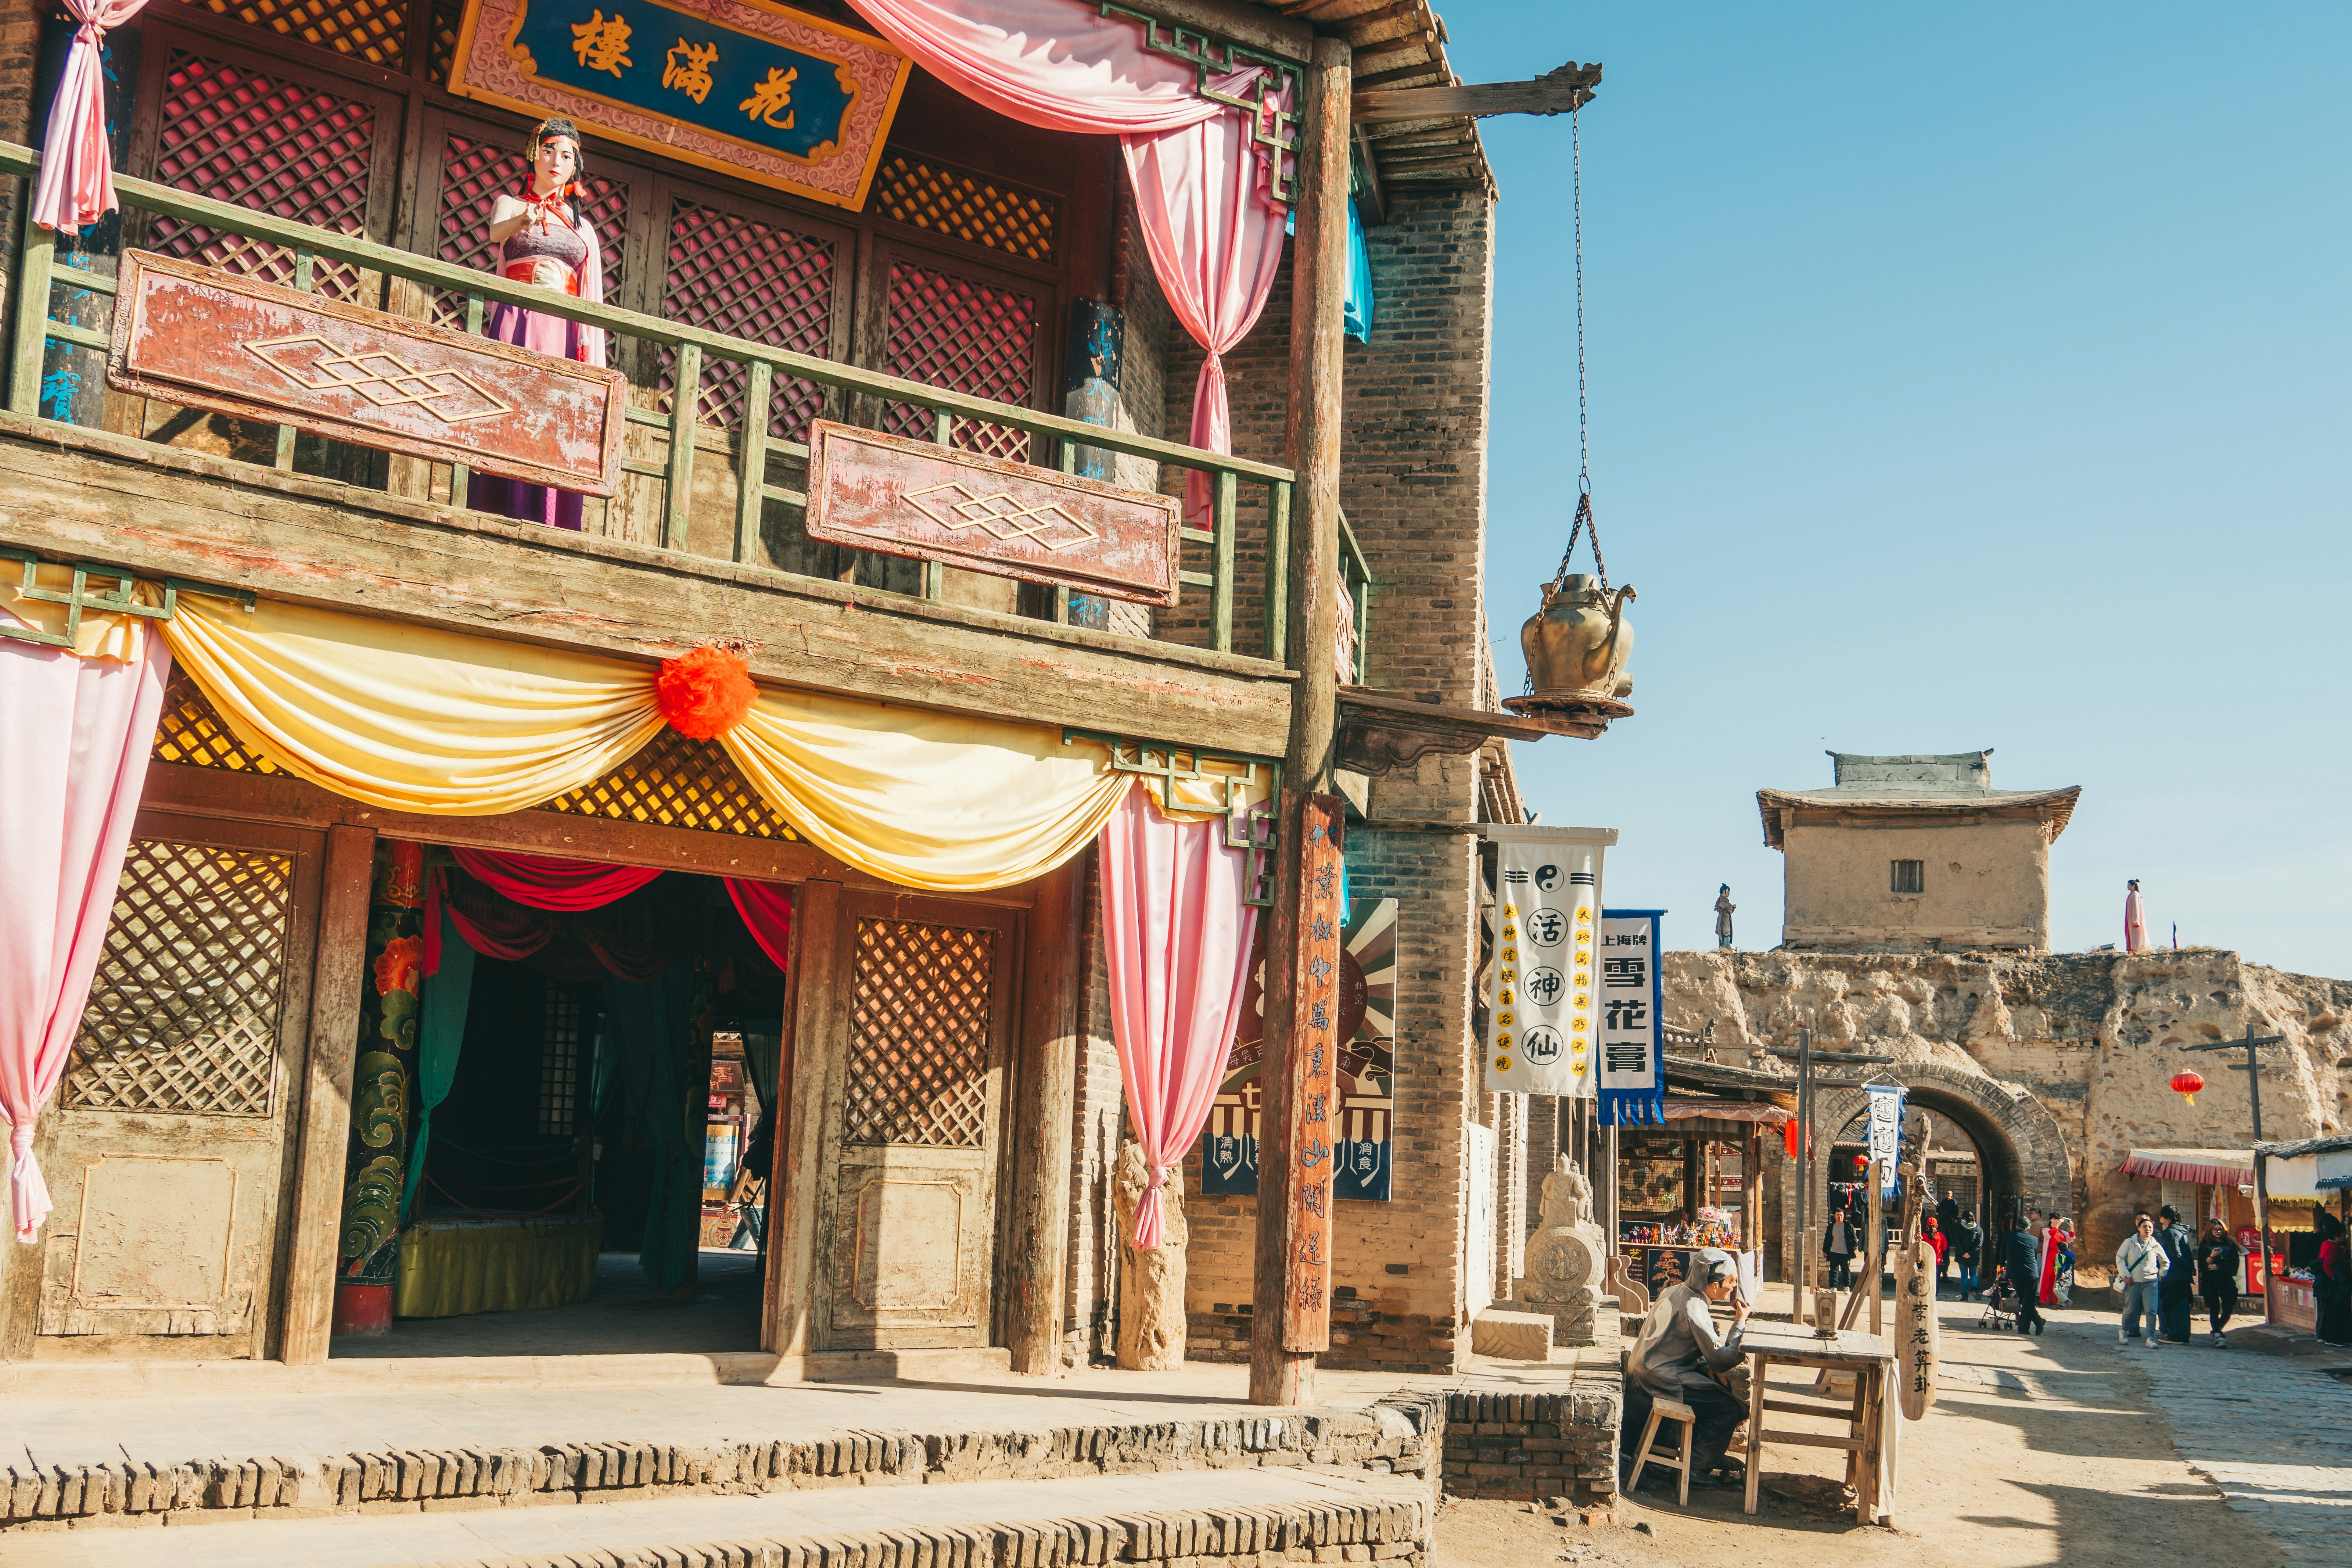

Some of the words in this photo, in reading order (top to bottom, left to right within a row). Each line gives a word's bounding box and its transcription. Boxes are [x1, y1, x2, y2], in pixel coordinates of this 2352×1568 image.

[1601, 934, 1647, 946] 上海牌
[1354, 982, 1365, 1005] 北京
[1527, 913, 1561, 1057] 活神仙
[1604, 957, 1647, 1073] 雪花膏
[1220, 1136, 1234, 1164] 清熱
[1358, 1142, 1373, 1170] 消食
[1910, 1300, 1932, 1395] 李老算卦
